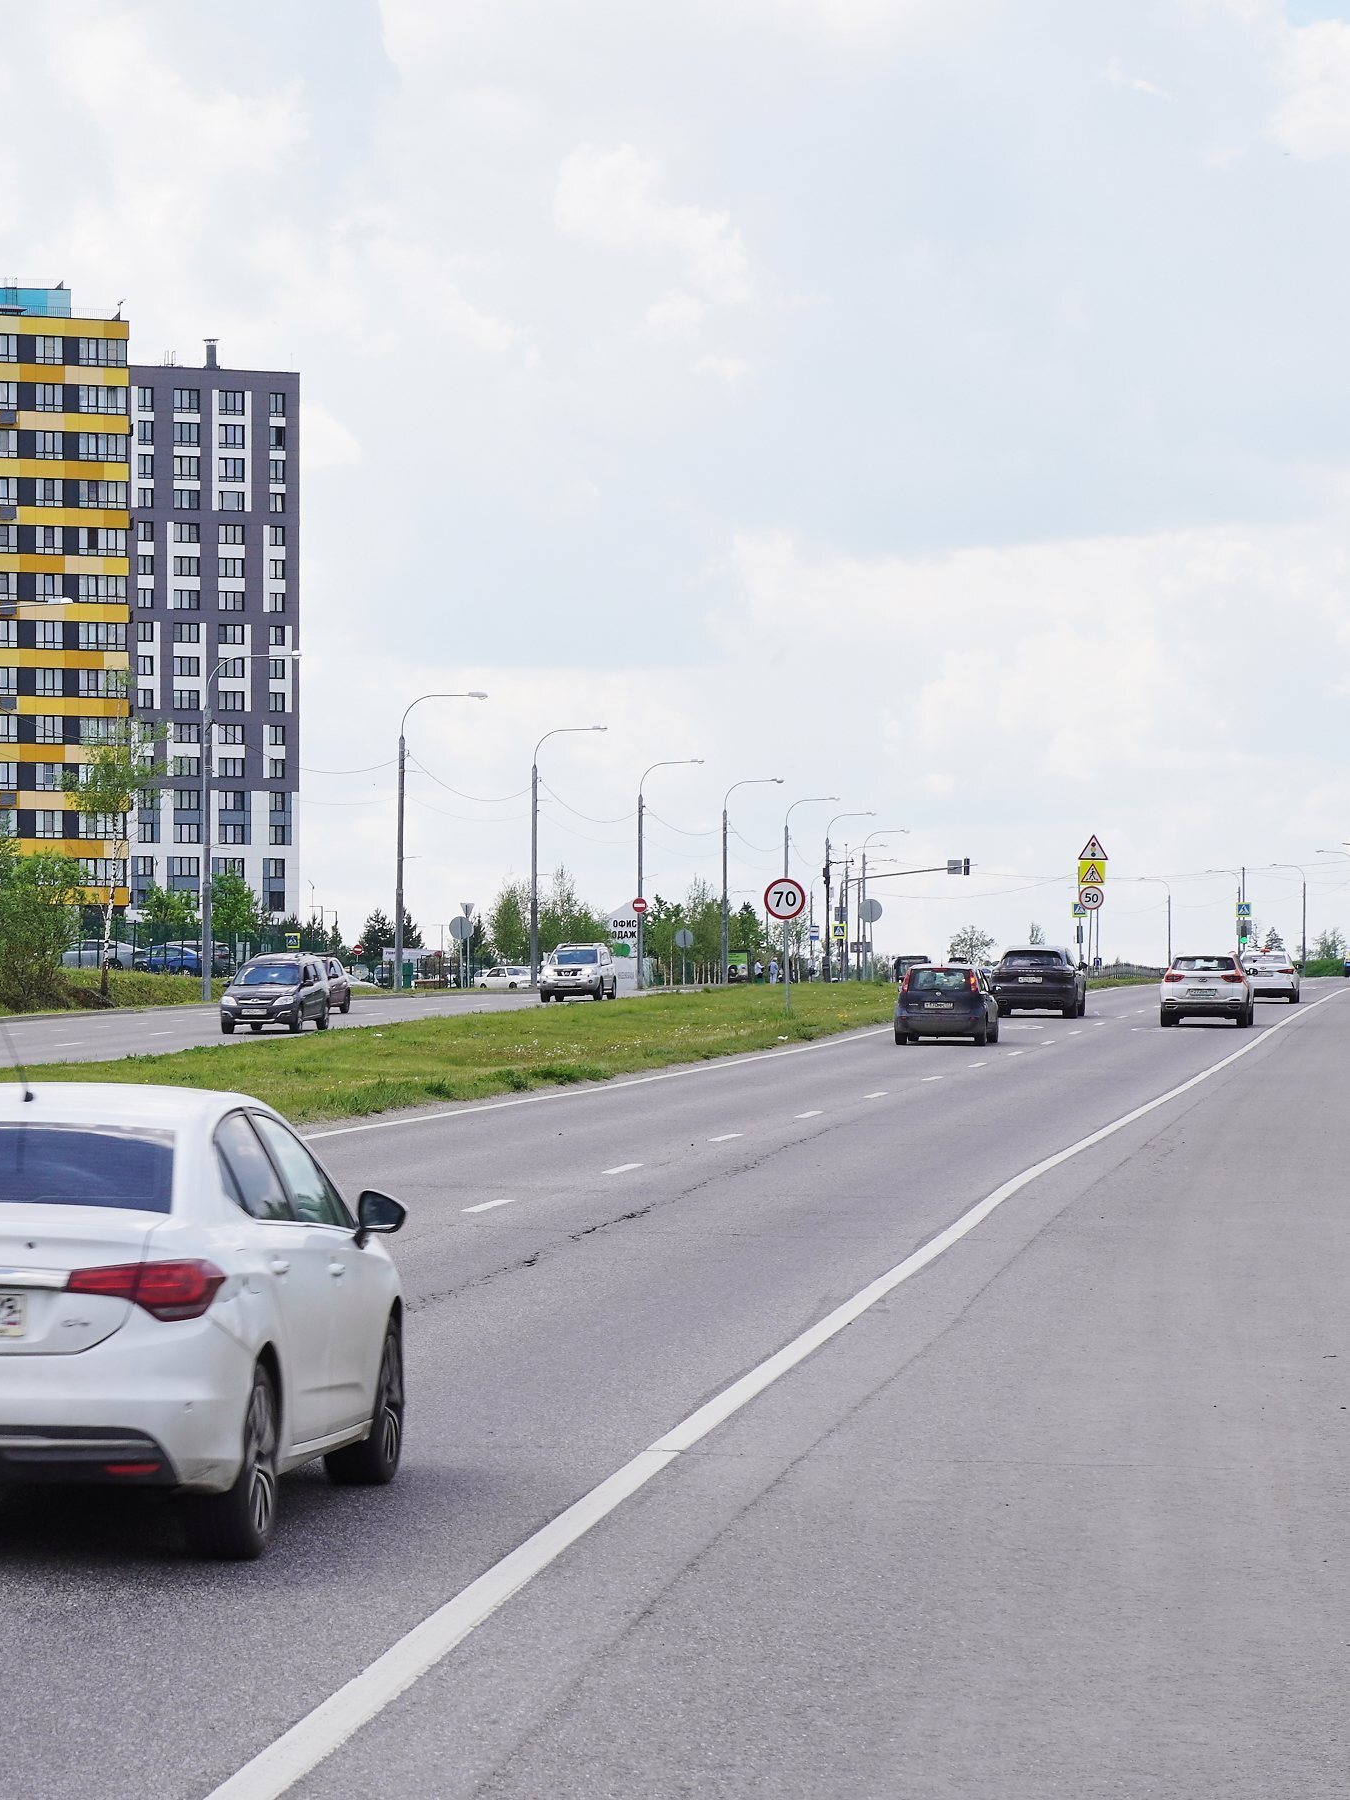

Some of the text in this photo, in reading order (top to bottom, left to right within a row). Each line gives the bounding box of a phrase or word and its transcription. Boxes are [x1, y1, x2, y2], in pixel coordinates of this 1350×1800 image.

[773, 890, 797, 908] 70
[1084, 892, 1099, 904] 50
[613, 919, 637, 928] ОФИС
